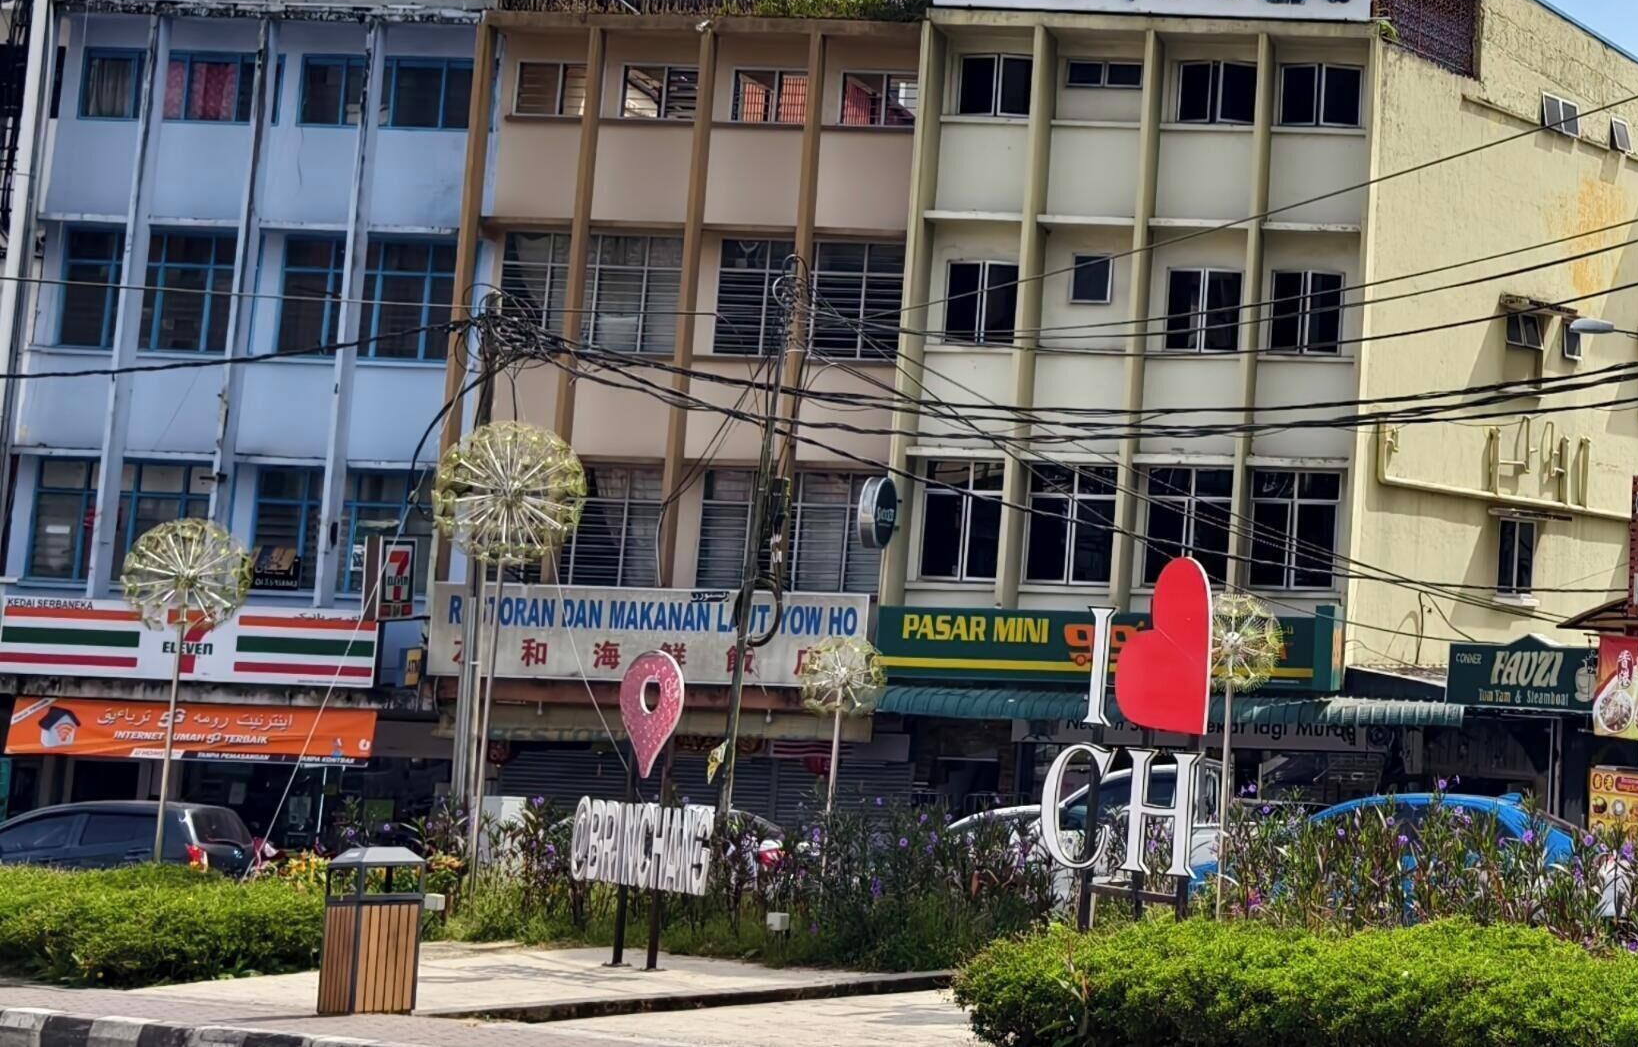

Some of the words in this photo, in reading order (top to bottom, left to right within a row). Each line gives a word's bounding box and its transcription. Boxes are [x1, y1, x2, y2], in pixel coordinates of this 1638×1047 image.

[7, 598, 36, 608] KEDAI
[37, 599, 94, 610] SERBANEKA
[448, 594, 555, 628] RTORAN
[561, 599, 602, 629] DAN
[609, 601, 711, 631] MAKANAN
[828, 607, 858, 636] HO
[902, 614, 987, 642] PASAR
[993, 616, 1050, 644] MINI
[1489, 650, 1564, 688] FAUZI
[113, 730, 165, 740] INTERNET
[170, 732, 204, 742] UMAH
[223, 734, 269, 745] TERBAIK
[1040, 742, 1206, 879] CH
